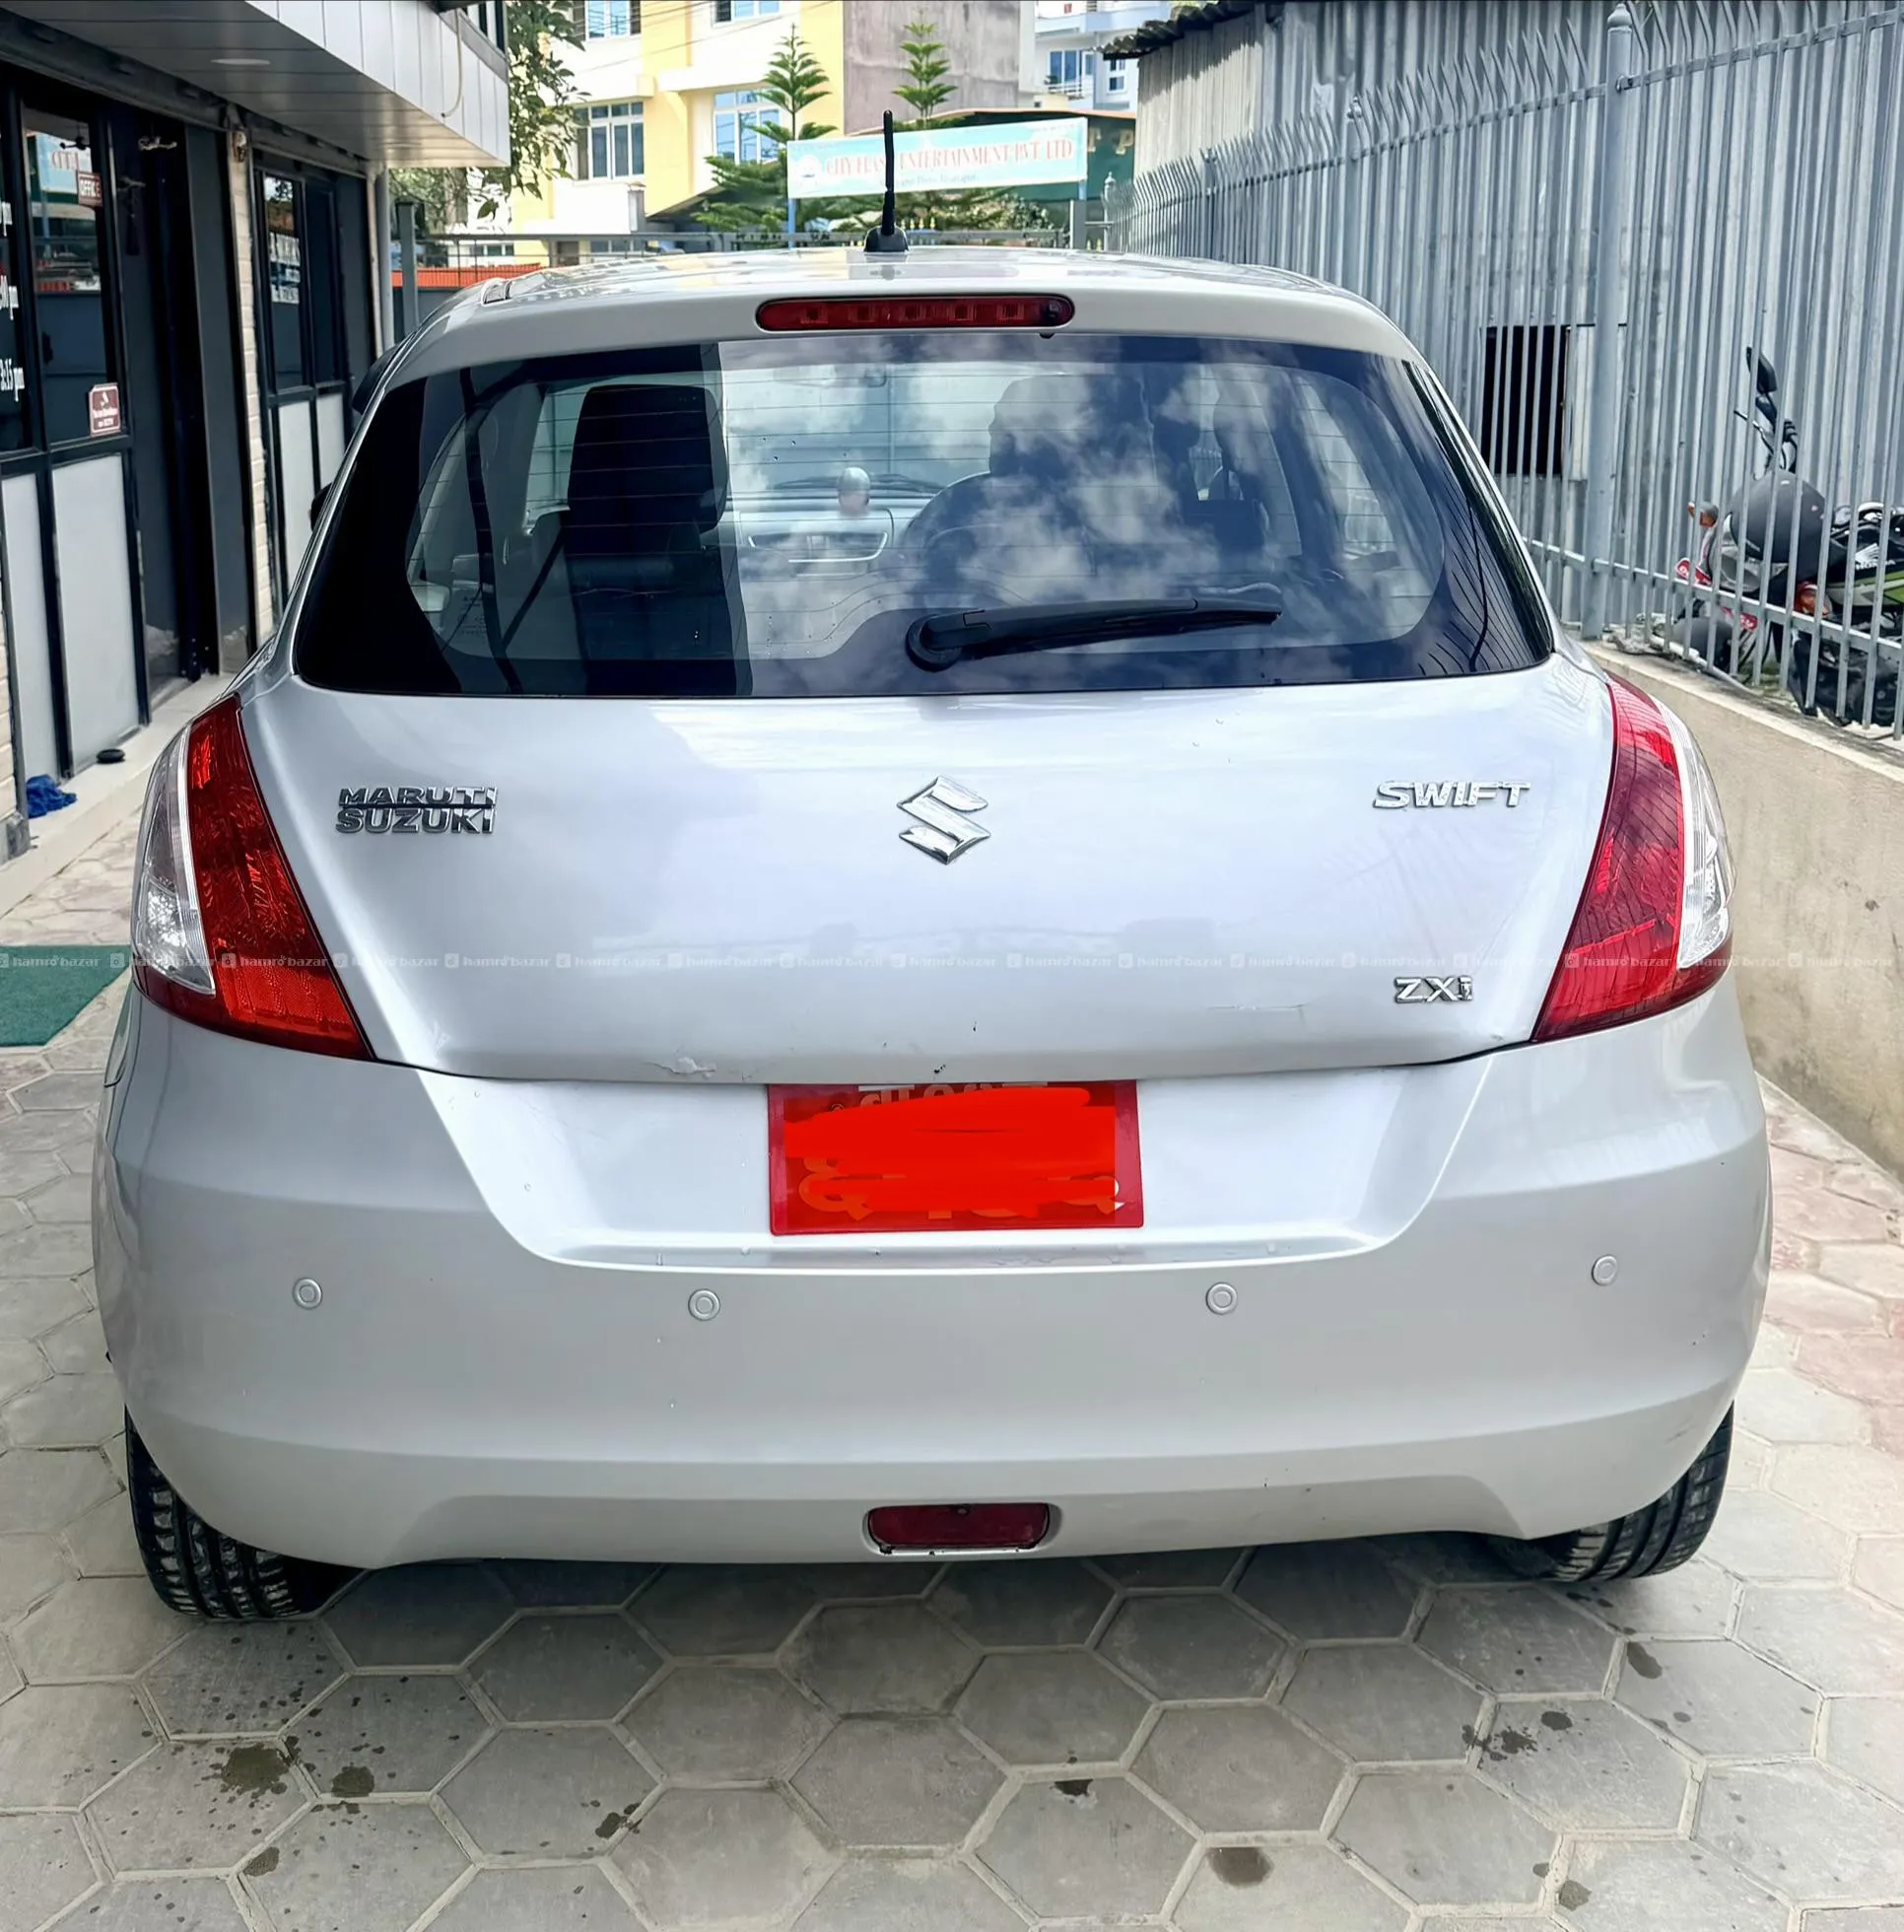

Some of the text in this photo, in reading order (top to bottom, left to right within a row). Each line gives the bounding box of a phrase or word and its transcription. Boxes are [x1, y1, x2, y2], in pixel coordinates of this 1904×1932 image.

[338, 786, 499, 807] MARUTI
[1373, 780, 1531, 809] SWIFT
[335, 807, 497, 834] SUZUKI
[1394, 975, 1473, 1003] ZXi
